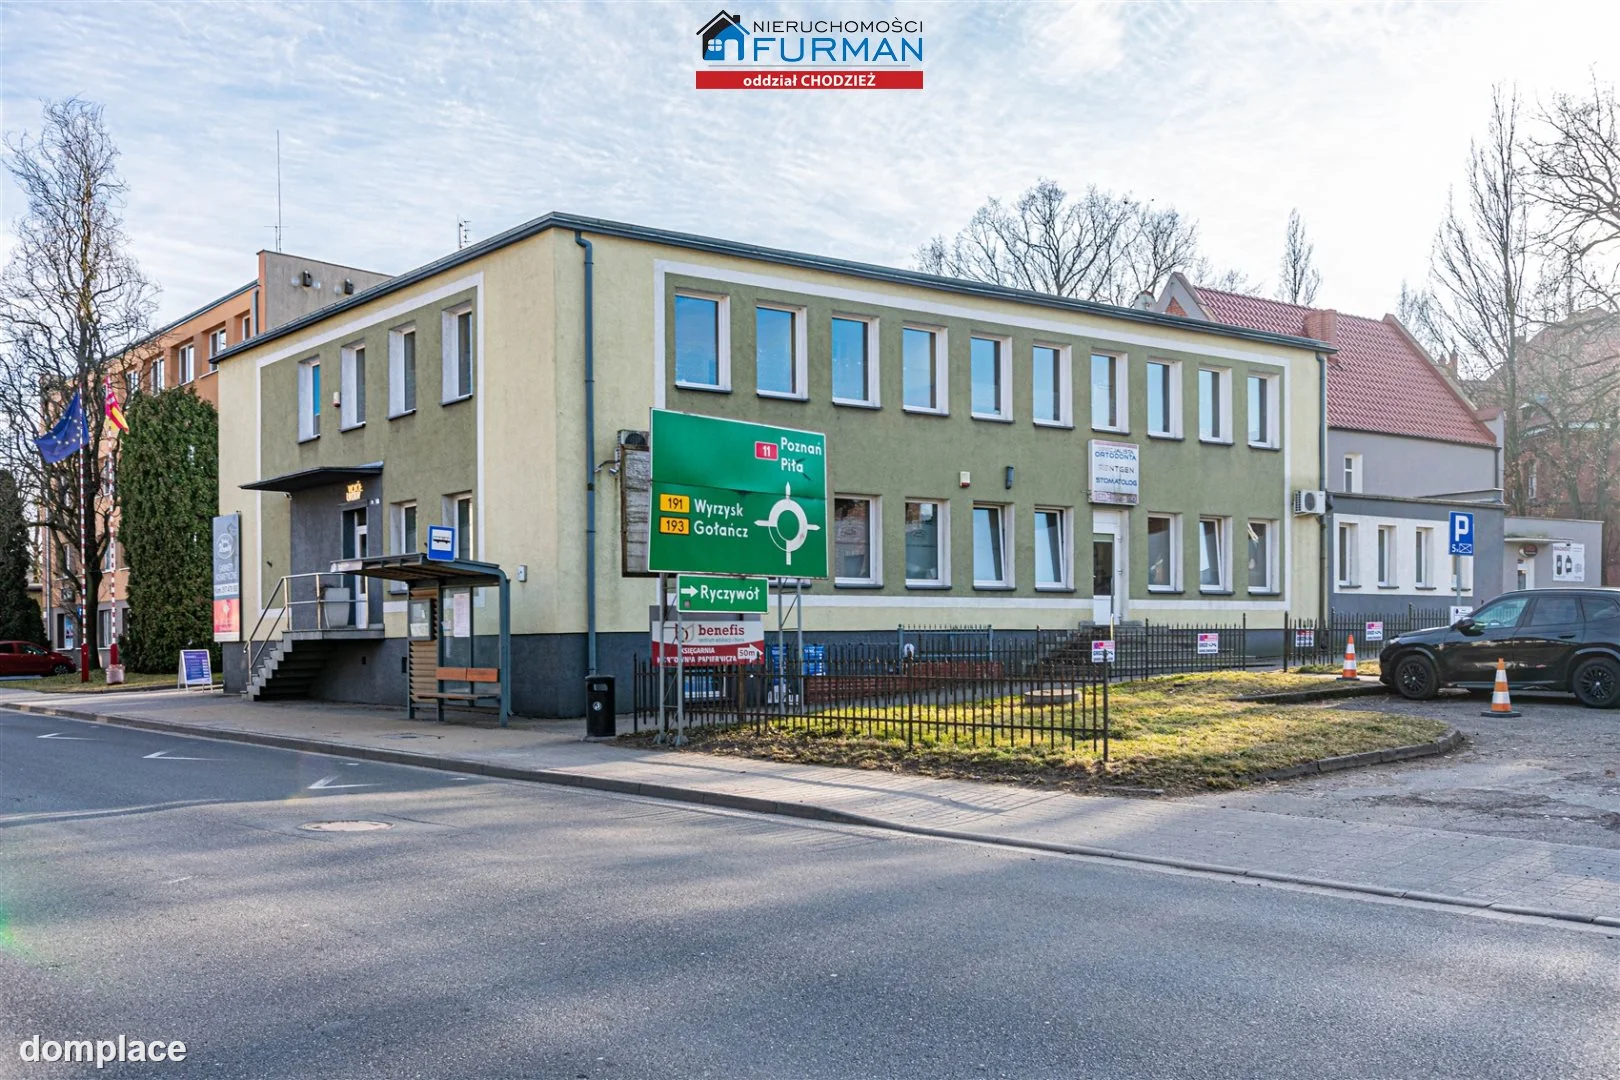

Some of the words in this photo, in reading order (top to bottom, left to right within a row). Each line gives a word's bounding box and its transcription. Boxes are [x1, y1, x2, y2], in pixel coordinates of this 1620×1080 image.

[762, 445, 772, 457] 11
[780, 436, 822, 455] Poznań
[1094, 451, 1137, 461] ORTODONTA
[781, 457, 804, 473] Piła
[1095, 477, 1137, 486] STOMATOLOG
[667, 497, 684, 510] 191
[694, 498, 744, 519] Wyrzysk
[666, 520, 685, 533] 193
[693, 520, 749, 538] Gołańcz
[1455, 515, 1469, 541] P
[700, 584, 760, 604] Ryczywół
[698, 624, 745, 636] benefis
[739, 649, 756, 657] 50m
